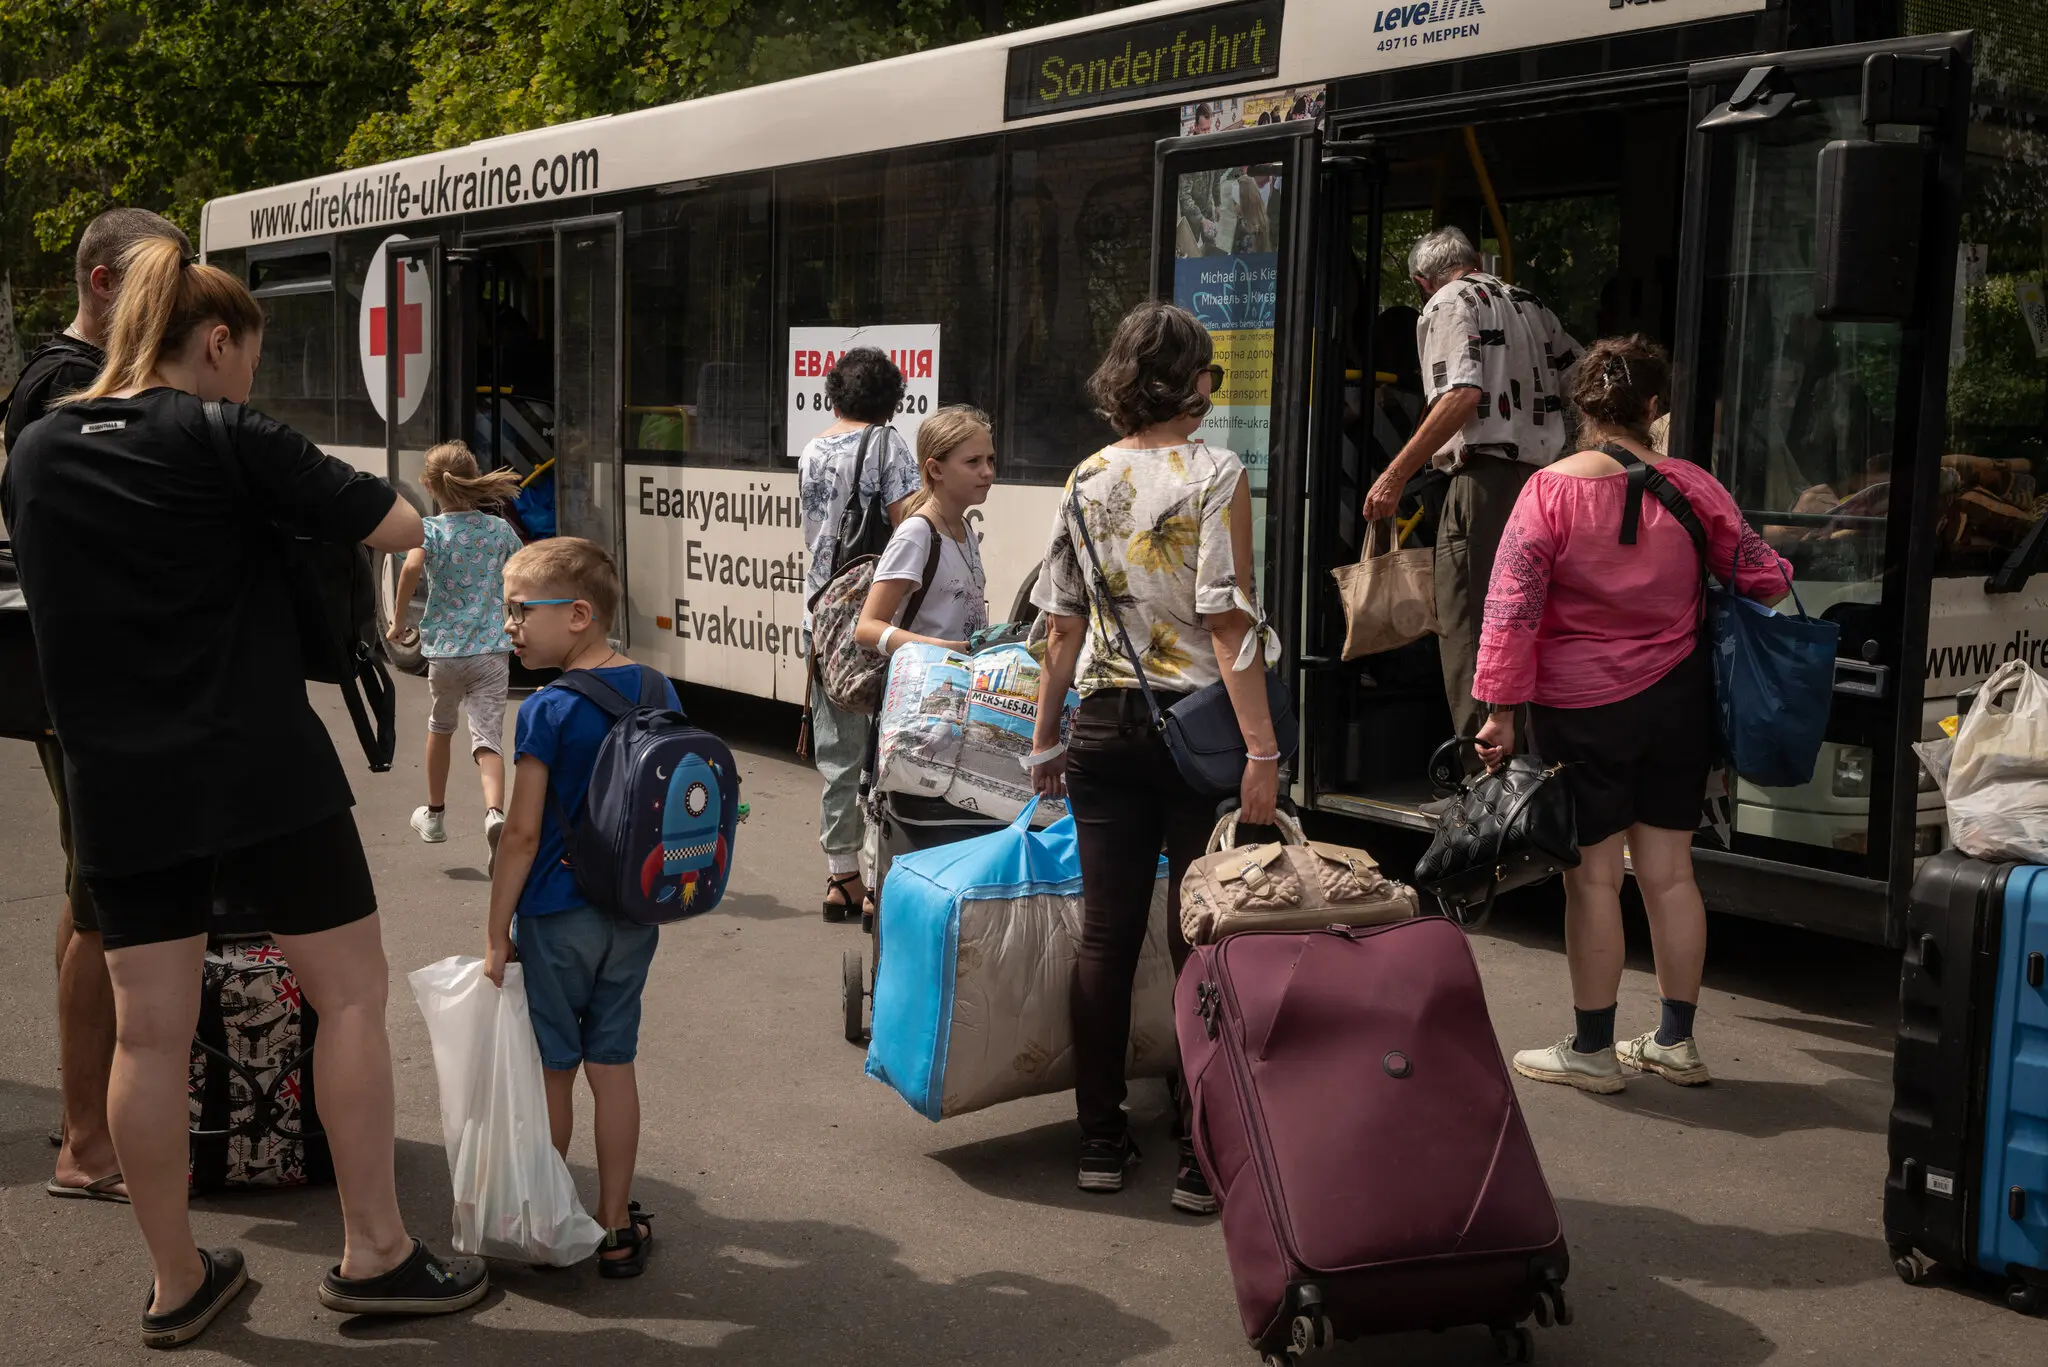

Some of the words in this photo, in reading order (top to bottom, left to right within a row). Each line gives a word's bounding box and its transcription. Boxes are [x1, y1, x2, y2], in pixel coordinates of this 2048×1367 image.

[1377, 34, 1418, 52] 49716
[1422, 23, 1480, 44] MEPPEN
[1039, 18, 1266, 100] Sonderfahrt
[250, 148, 599, 240] www.direkthilfe-ukraine.com
[1200, 269, 1238, 284] Michael
[1239, 272, 1258, 282] aus
[794, 349, 932, 383] ЕВАЦІЯ
[796, 392, 805, 411] 0
[1199, 415, 1269, 429] irekthilfe-ukra
